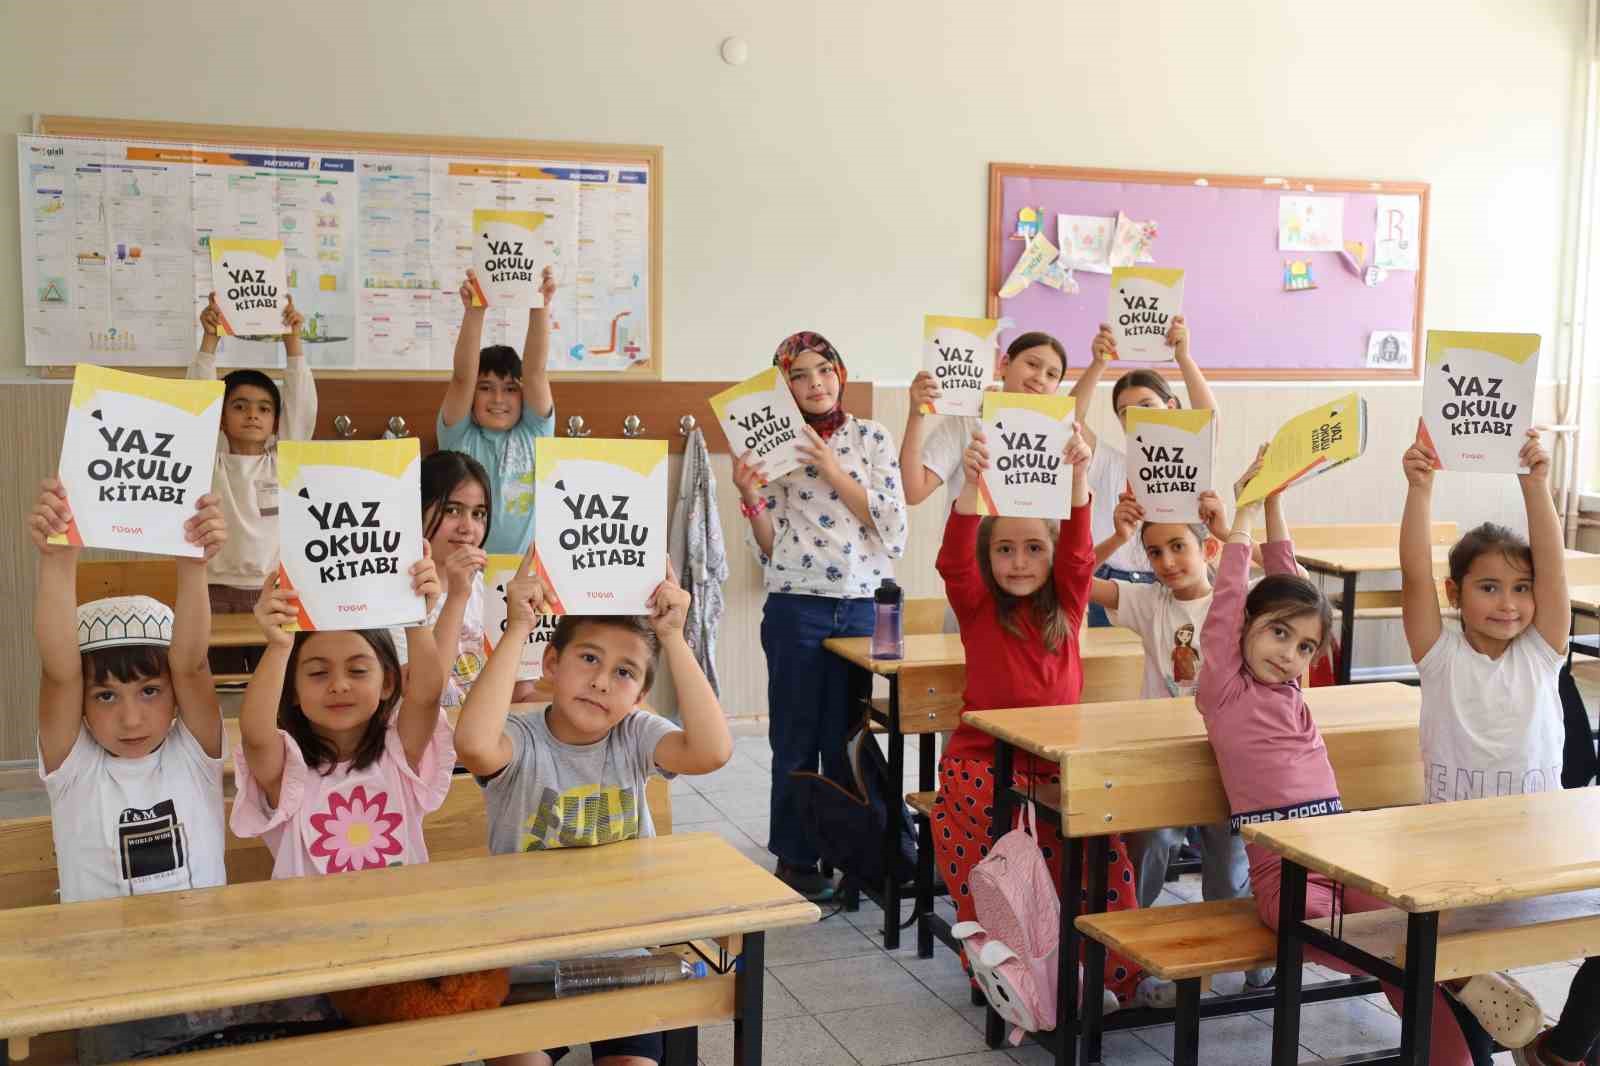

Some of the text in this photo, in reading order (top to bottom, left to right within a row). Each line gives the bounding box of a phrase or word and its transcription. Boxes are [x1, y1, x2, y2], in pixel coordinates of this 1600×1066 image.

[488, 241, 524, 256] YAZ
[485, 257, 533, 272] OKULU
[228, 270, 266, 284] YAZ
[228, 285, 278, 300] OKULU
[1124, 296, 1158, 310] YAZ
[1119, 311, 1168, 325] OKULU
[939, 347, 973, 363] YAZ
[935, 364, 983, 379] OKULU
[1448, 376, 1503, 399] YAZ
[738, 406, 775, 431] YAZ
[1441, 400, 1517, 421] OKULU
[745, 417, 792, 447] OKULU
[1330, 422, 1342, 443] YAZ
[1451, 419, 1513, 437] KİTABI
[99, 426, 175, 458] YAZ
[1001, 432, 1047, 452] YAZ
[996, 454, 1060, 472] OKULU
[1141, 446, 1183, 463] YAZ
[88, 458, 192, 484] OKULU
[1004, 472, 1057, 485] KİTABI
[1139, 464, 1198, 481] OKULU
[98, 485, 186, 505] KİTABI
[1147, 480, 1196, 494] KİTABI
[308, 502, 381, 530] YAZ
[563, 494, 630, 520] YAZ
[559, 523, 649, 550] OKULU
[304, 531, 400, 562] OKULU
[572, 549, 646, 570] KİTABI
[320, 557, 399, 583] KİTABI
[1288, 801, 1327, 820] good
[128, 836, 154, 846] WORLD
